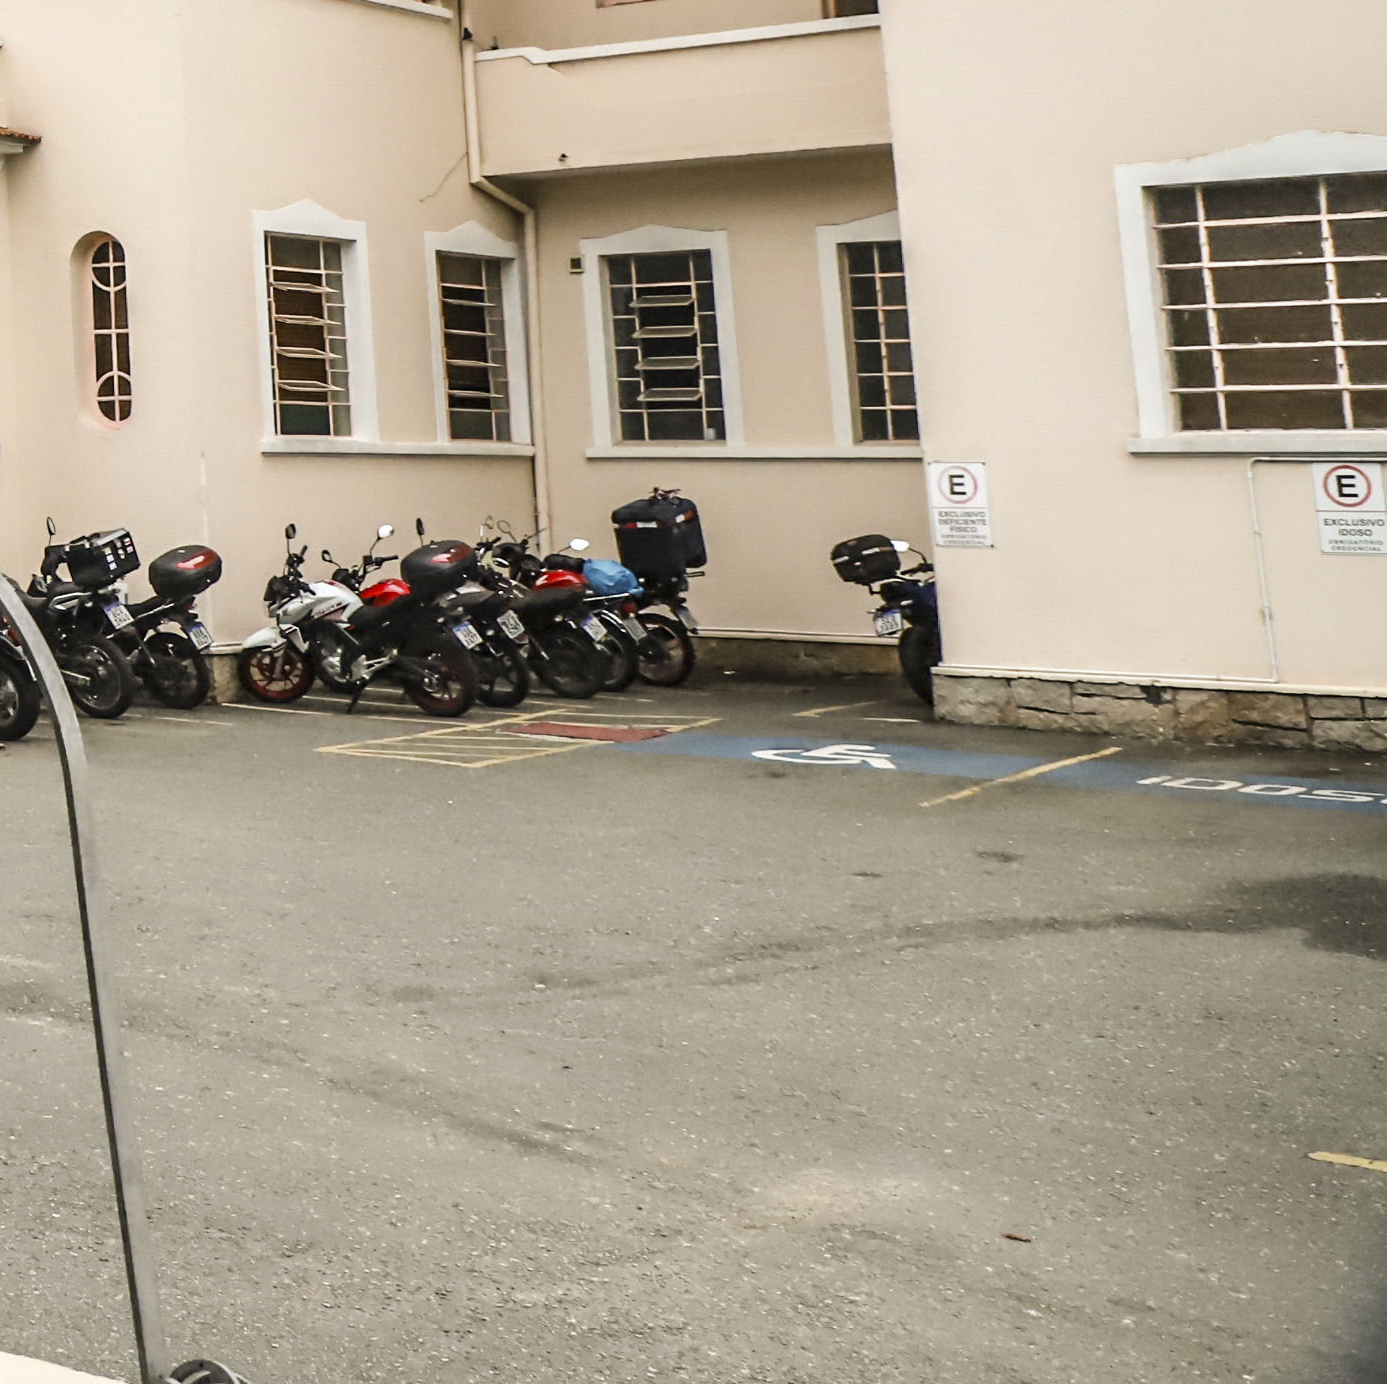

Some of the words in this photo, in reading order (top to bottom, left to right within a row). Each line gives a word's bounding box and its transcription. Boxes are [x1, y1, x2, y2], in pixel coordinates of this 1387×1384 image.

[949, 474, 967, 495] E
[1336, 474, 1359, 498] E
[1323, 518, 1385, 527] EXCLUSIVO
[1338, 528, 1373, 537] IDOSO
[1136, 775, 1387, 805] IDOS
